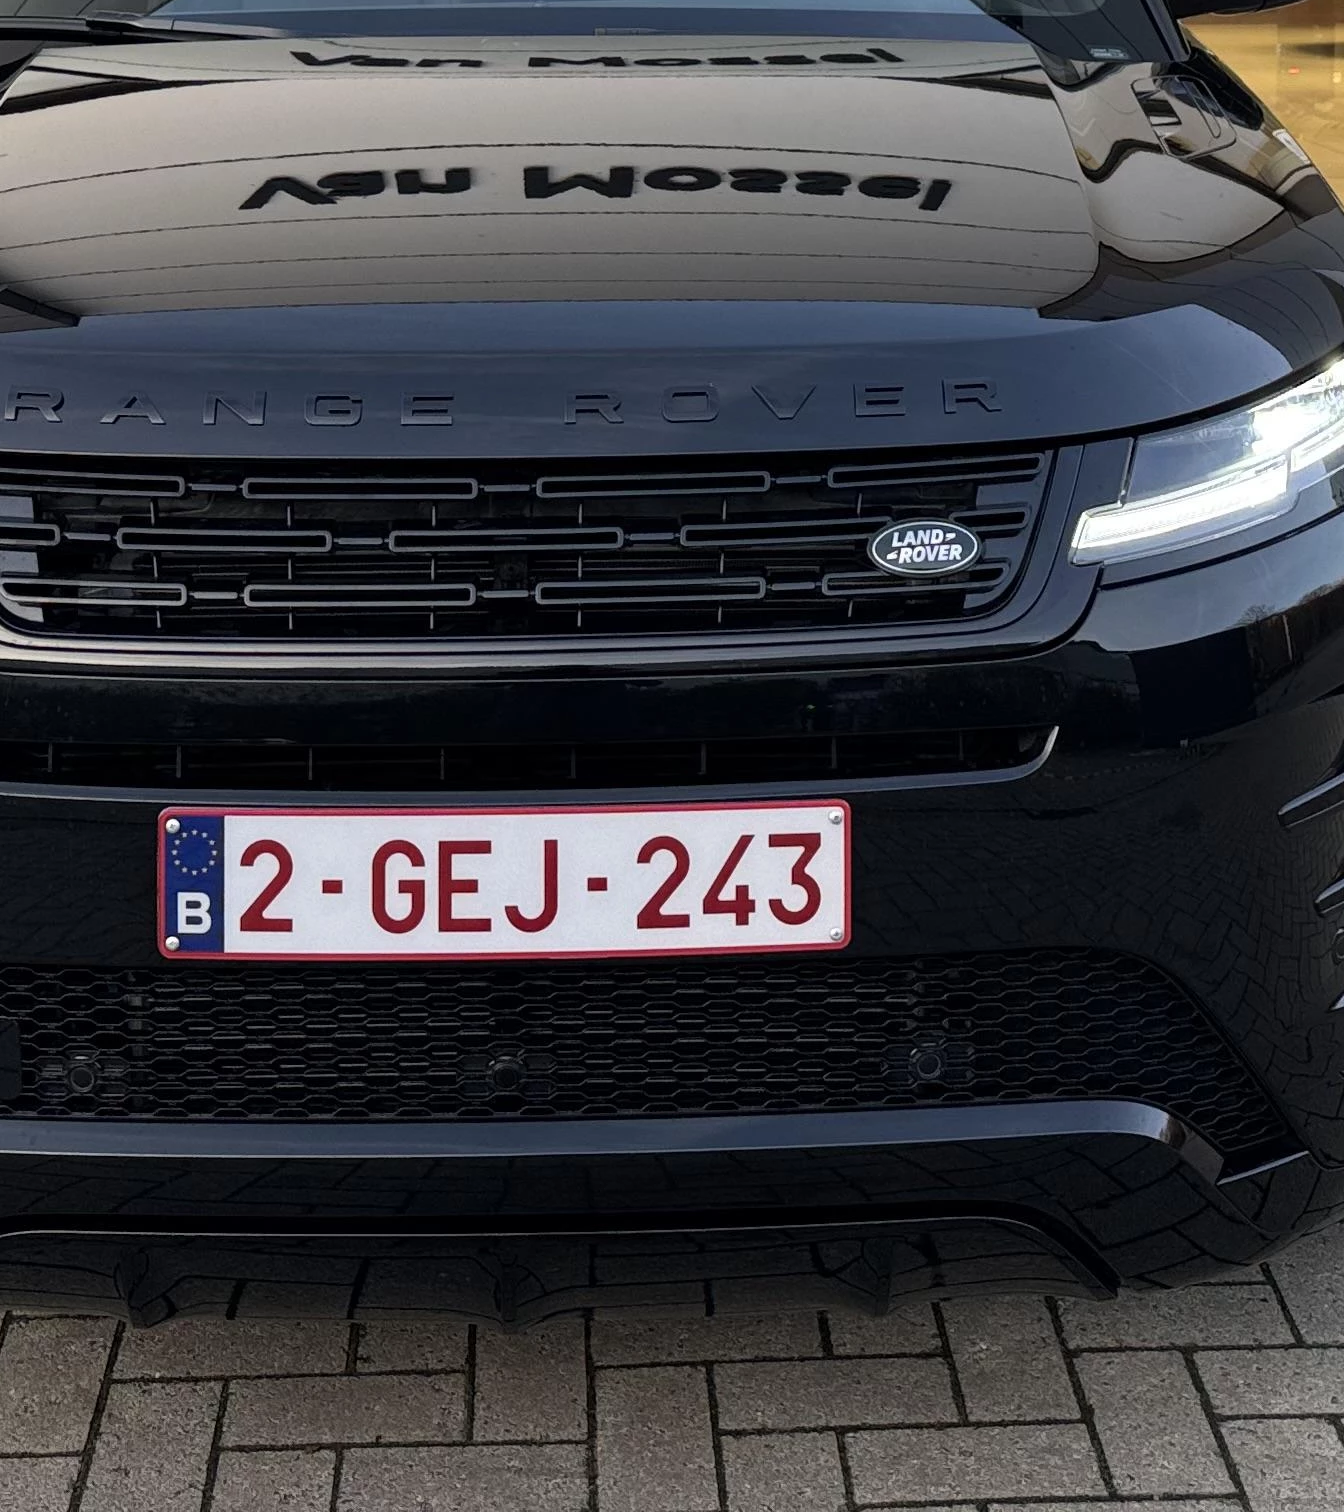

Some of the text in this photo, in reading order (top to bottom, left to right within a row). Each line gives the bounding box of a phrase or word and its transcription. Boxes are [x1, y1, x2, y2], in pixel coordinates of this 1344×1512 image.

[3, 377, 1003, 427] RANGE ROVER
[891, 529, 945, 548] LAND
[898, 544, 964, 565] ROVER
[238, 831, 823, 935] 2-GEJ-243
[176, 891, 213, 935] B
